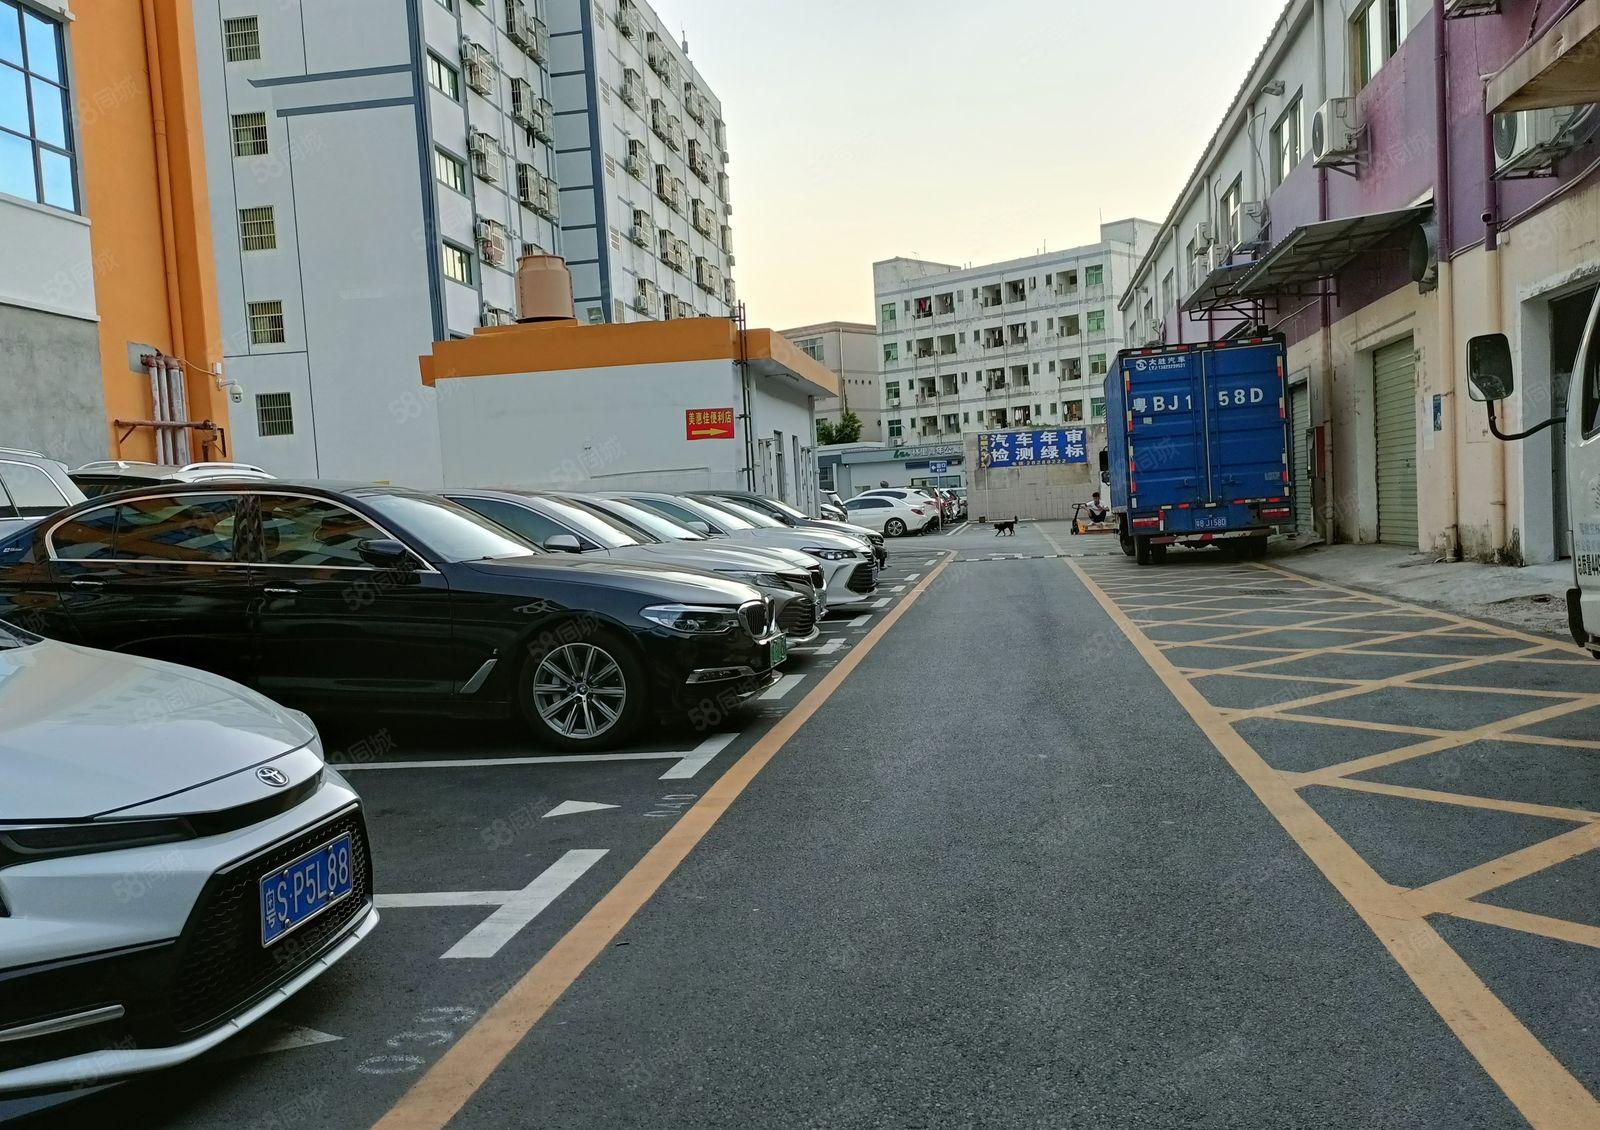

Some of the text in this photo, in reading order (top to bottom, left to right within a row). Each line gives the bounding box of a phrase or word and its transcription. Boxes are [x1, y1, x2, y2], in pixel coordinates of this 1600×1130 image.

[990, 429, 1083, 448] 汽车年审
[990, 444, 1084, 462] 检测绿标
